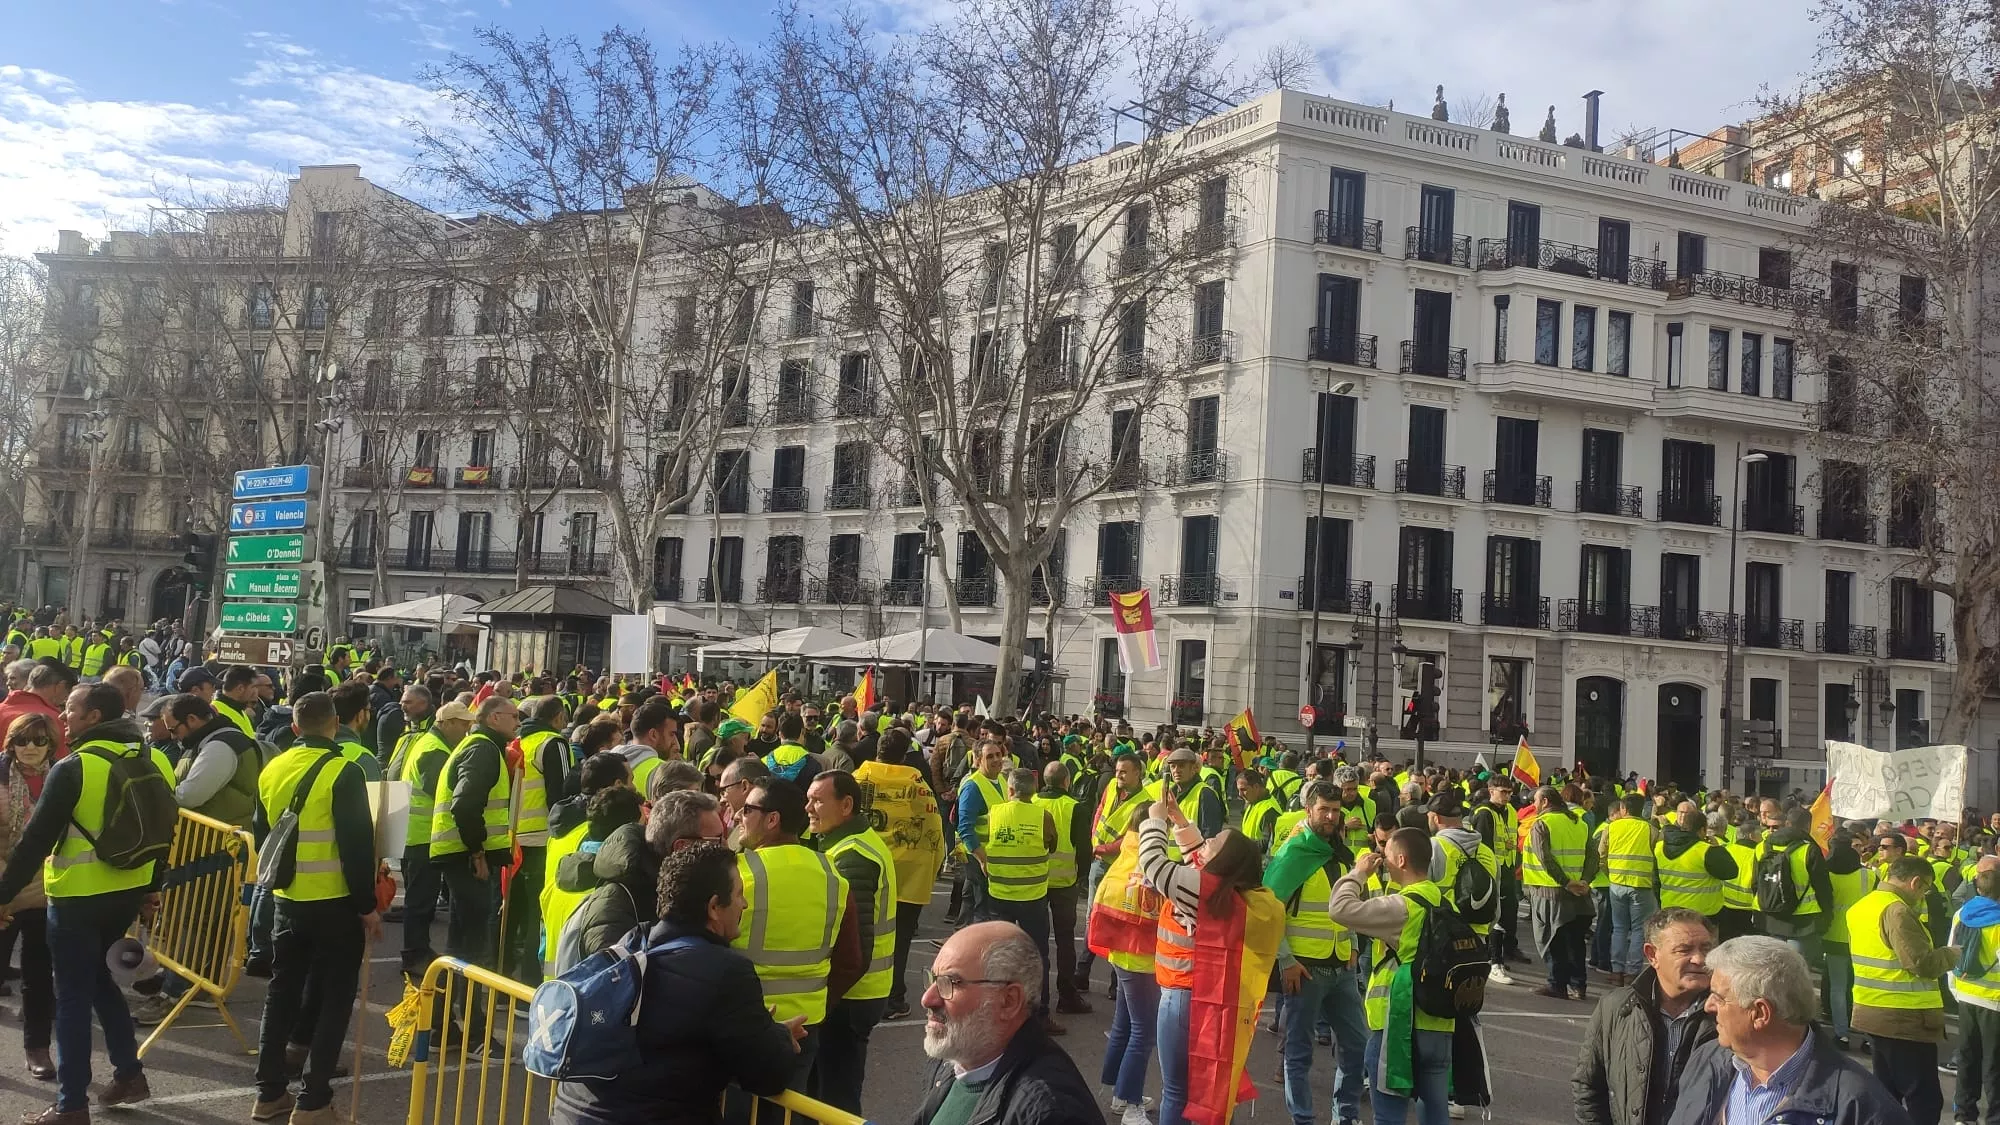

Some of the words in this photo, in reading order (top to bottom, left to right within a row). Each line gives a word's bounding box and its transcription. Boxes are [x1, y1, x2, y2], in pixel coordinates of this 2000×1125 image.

[275, 509, 304, 520] Valencia
[289, 538, 302, 546] calle
[267, 548, 301, 558] O'Donnell
[276, 573, 289, 581] plaza
[249, 582, 271, 592] Manuel
[274, 583, 297, 592] Becerra
[222, 614, 235, 622] plaza
[245, 612, 270, 622] Cibeles
[219, 649, 246, 661] América
